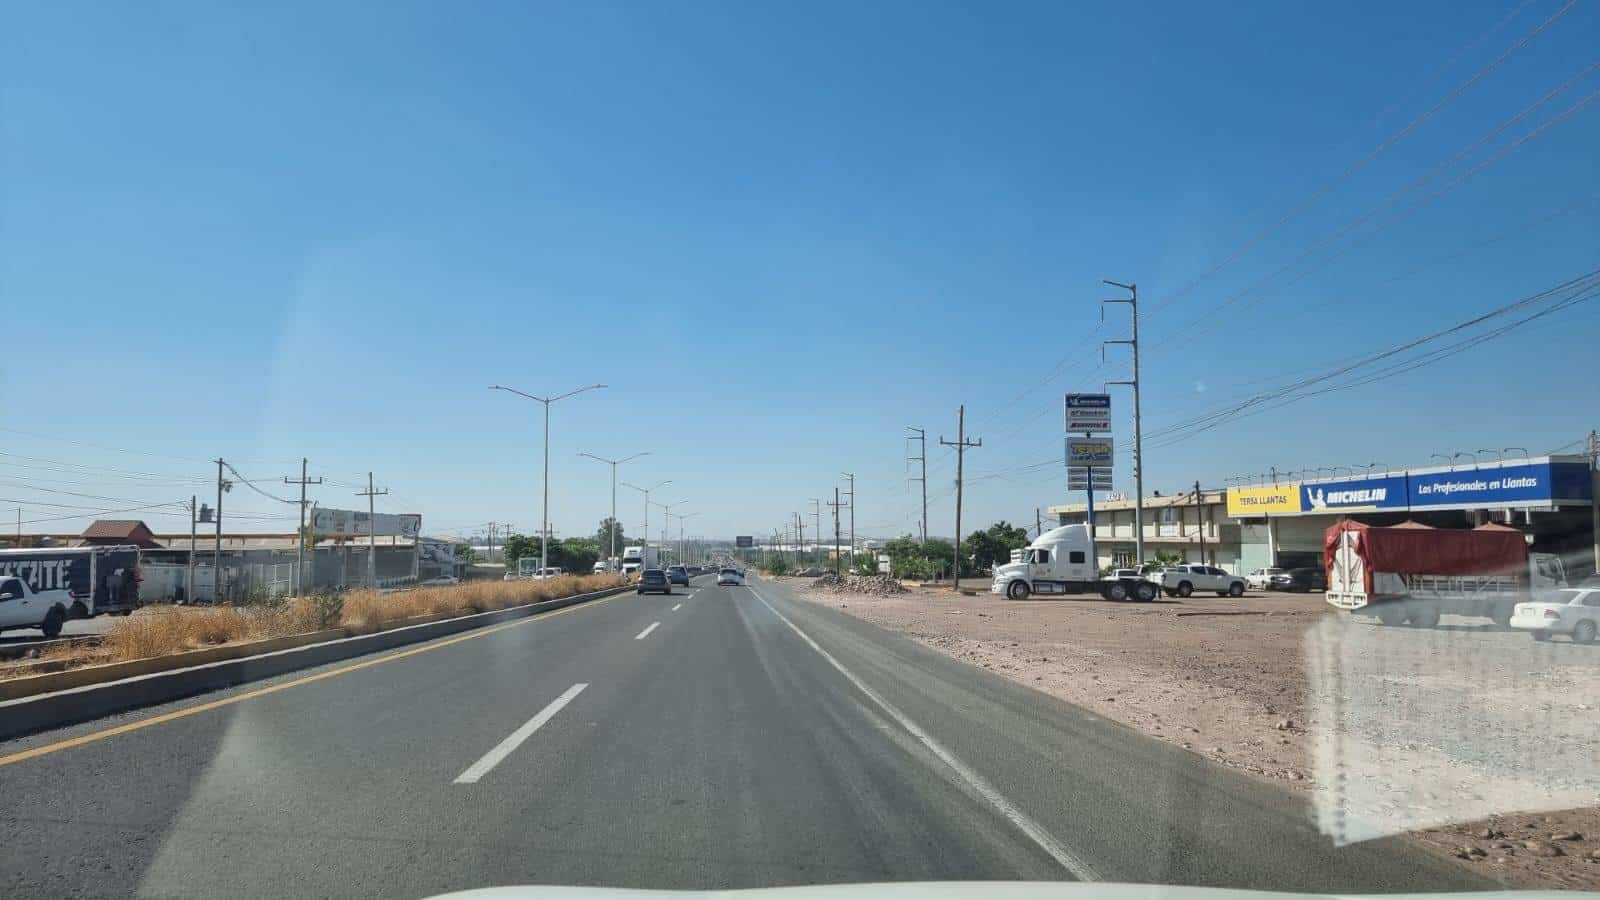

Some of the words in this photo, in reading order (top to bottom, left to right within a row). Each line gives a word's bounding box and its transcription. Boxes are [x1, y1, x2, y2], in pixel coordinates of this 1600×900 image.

[1433, 480, 1487, 496] Profesionales
[1489, 481, 1500, 490] en
[1502, 478, 1537, 488] Llantas
[1240, 497, 1258, 505] TERSA
[1260, 495, 1287, 505] LLANTAS
[1327, 488, 1387, 503] MICHELIN
